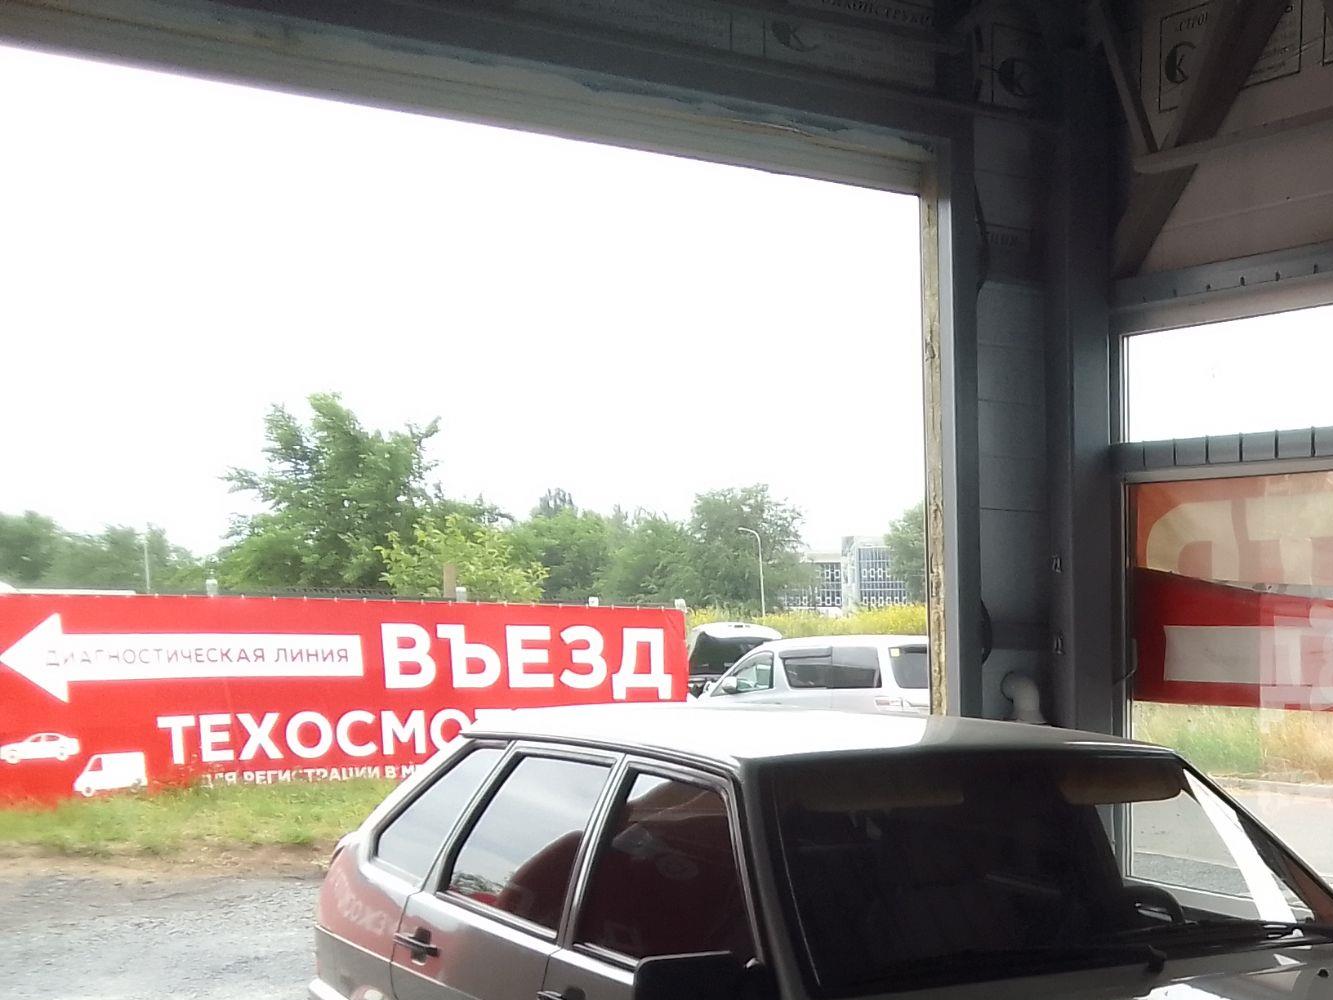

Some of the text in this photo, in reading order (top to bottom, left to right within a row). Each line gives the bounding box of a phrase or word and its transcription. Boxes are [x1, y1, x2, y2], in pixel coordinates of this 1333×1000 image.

[46, 647, 349, 667] ДИАГНОСТИЧЕСКАЯ ЛИНИЯ
[381, 622, 673, 702] ВЪЕЗД
[157, 707, 520, 765] ТЕХОСМО
